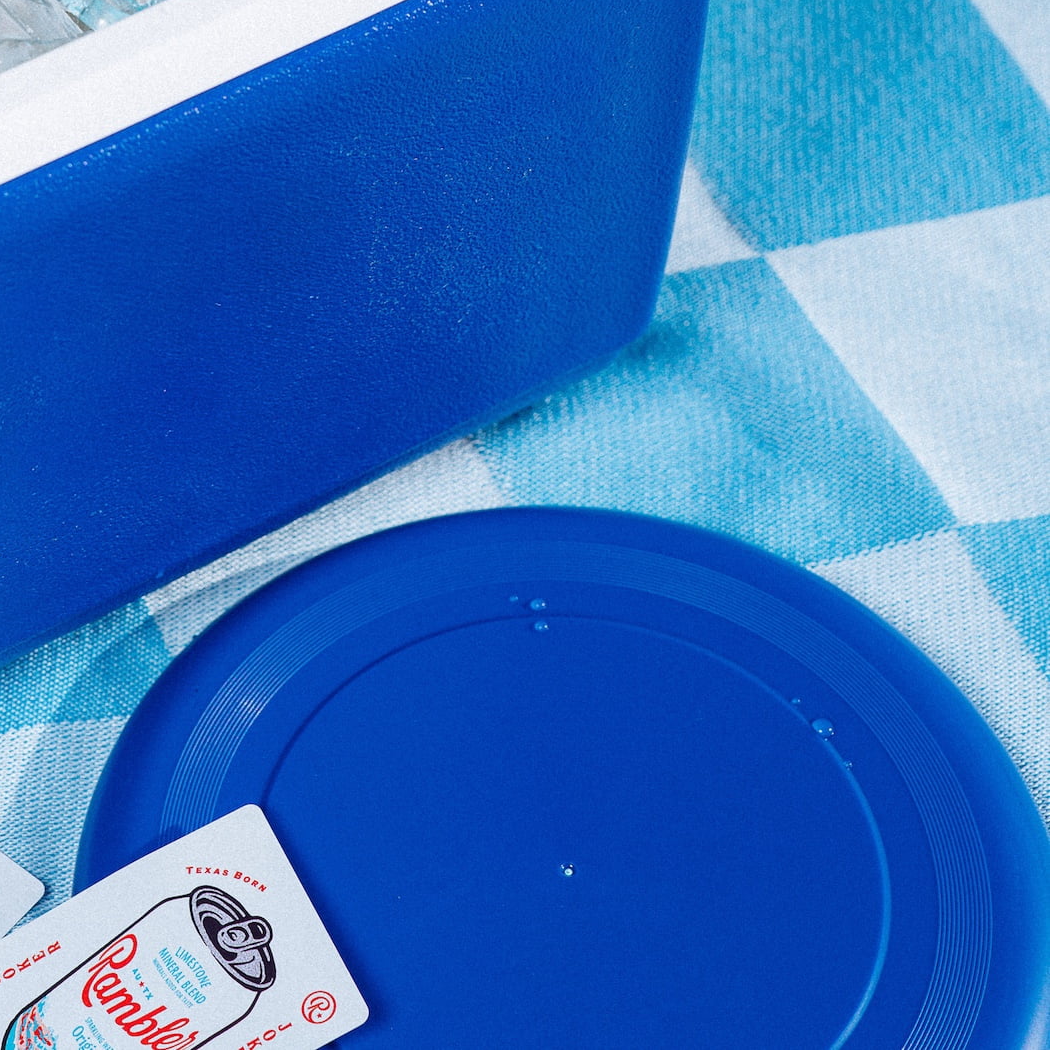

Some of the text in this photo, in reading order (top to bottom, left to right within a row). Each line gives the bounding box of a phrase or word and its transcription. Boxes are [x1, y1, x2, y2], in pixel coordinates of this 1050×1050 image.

[132, 968, 154, 1000] AU TX
[159, 947, 206, 1004] MINERAL BLEND
[175, 946, 212, 988] LIMESTONE
